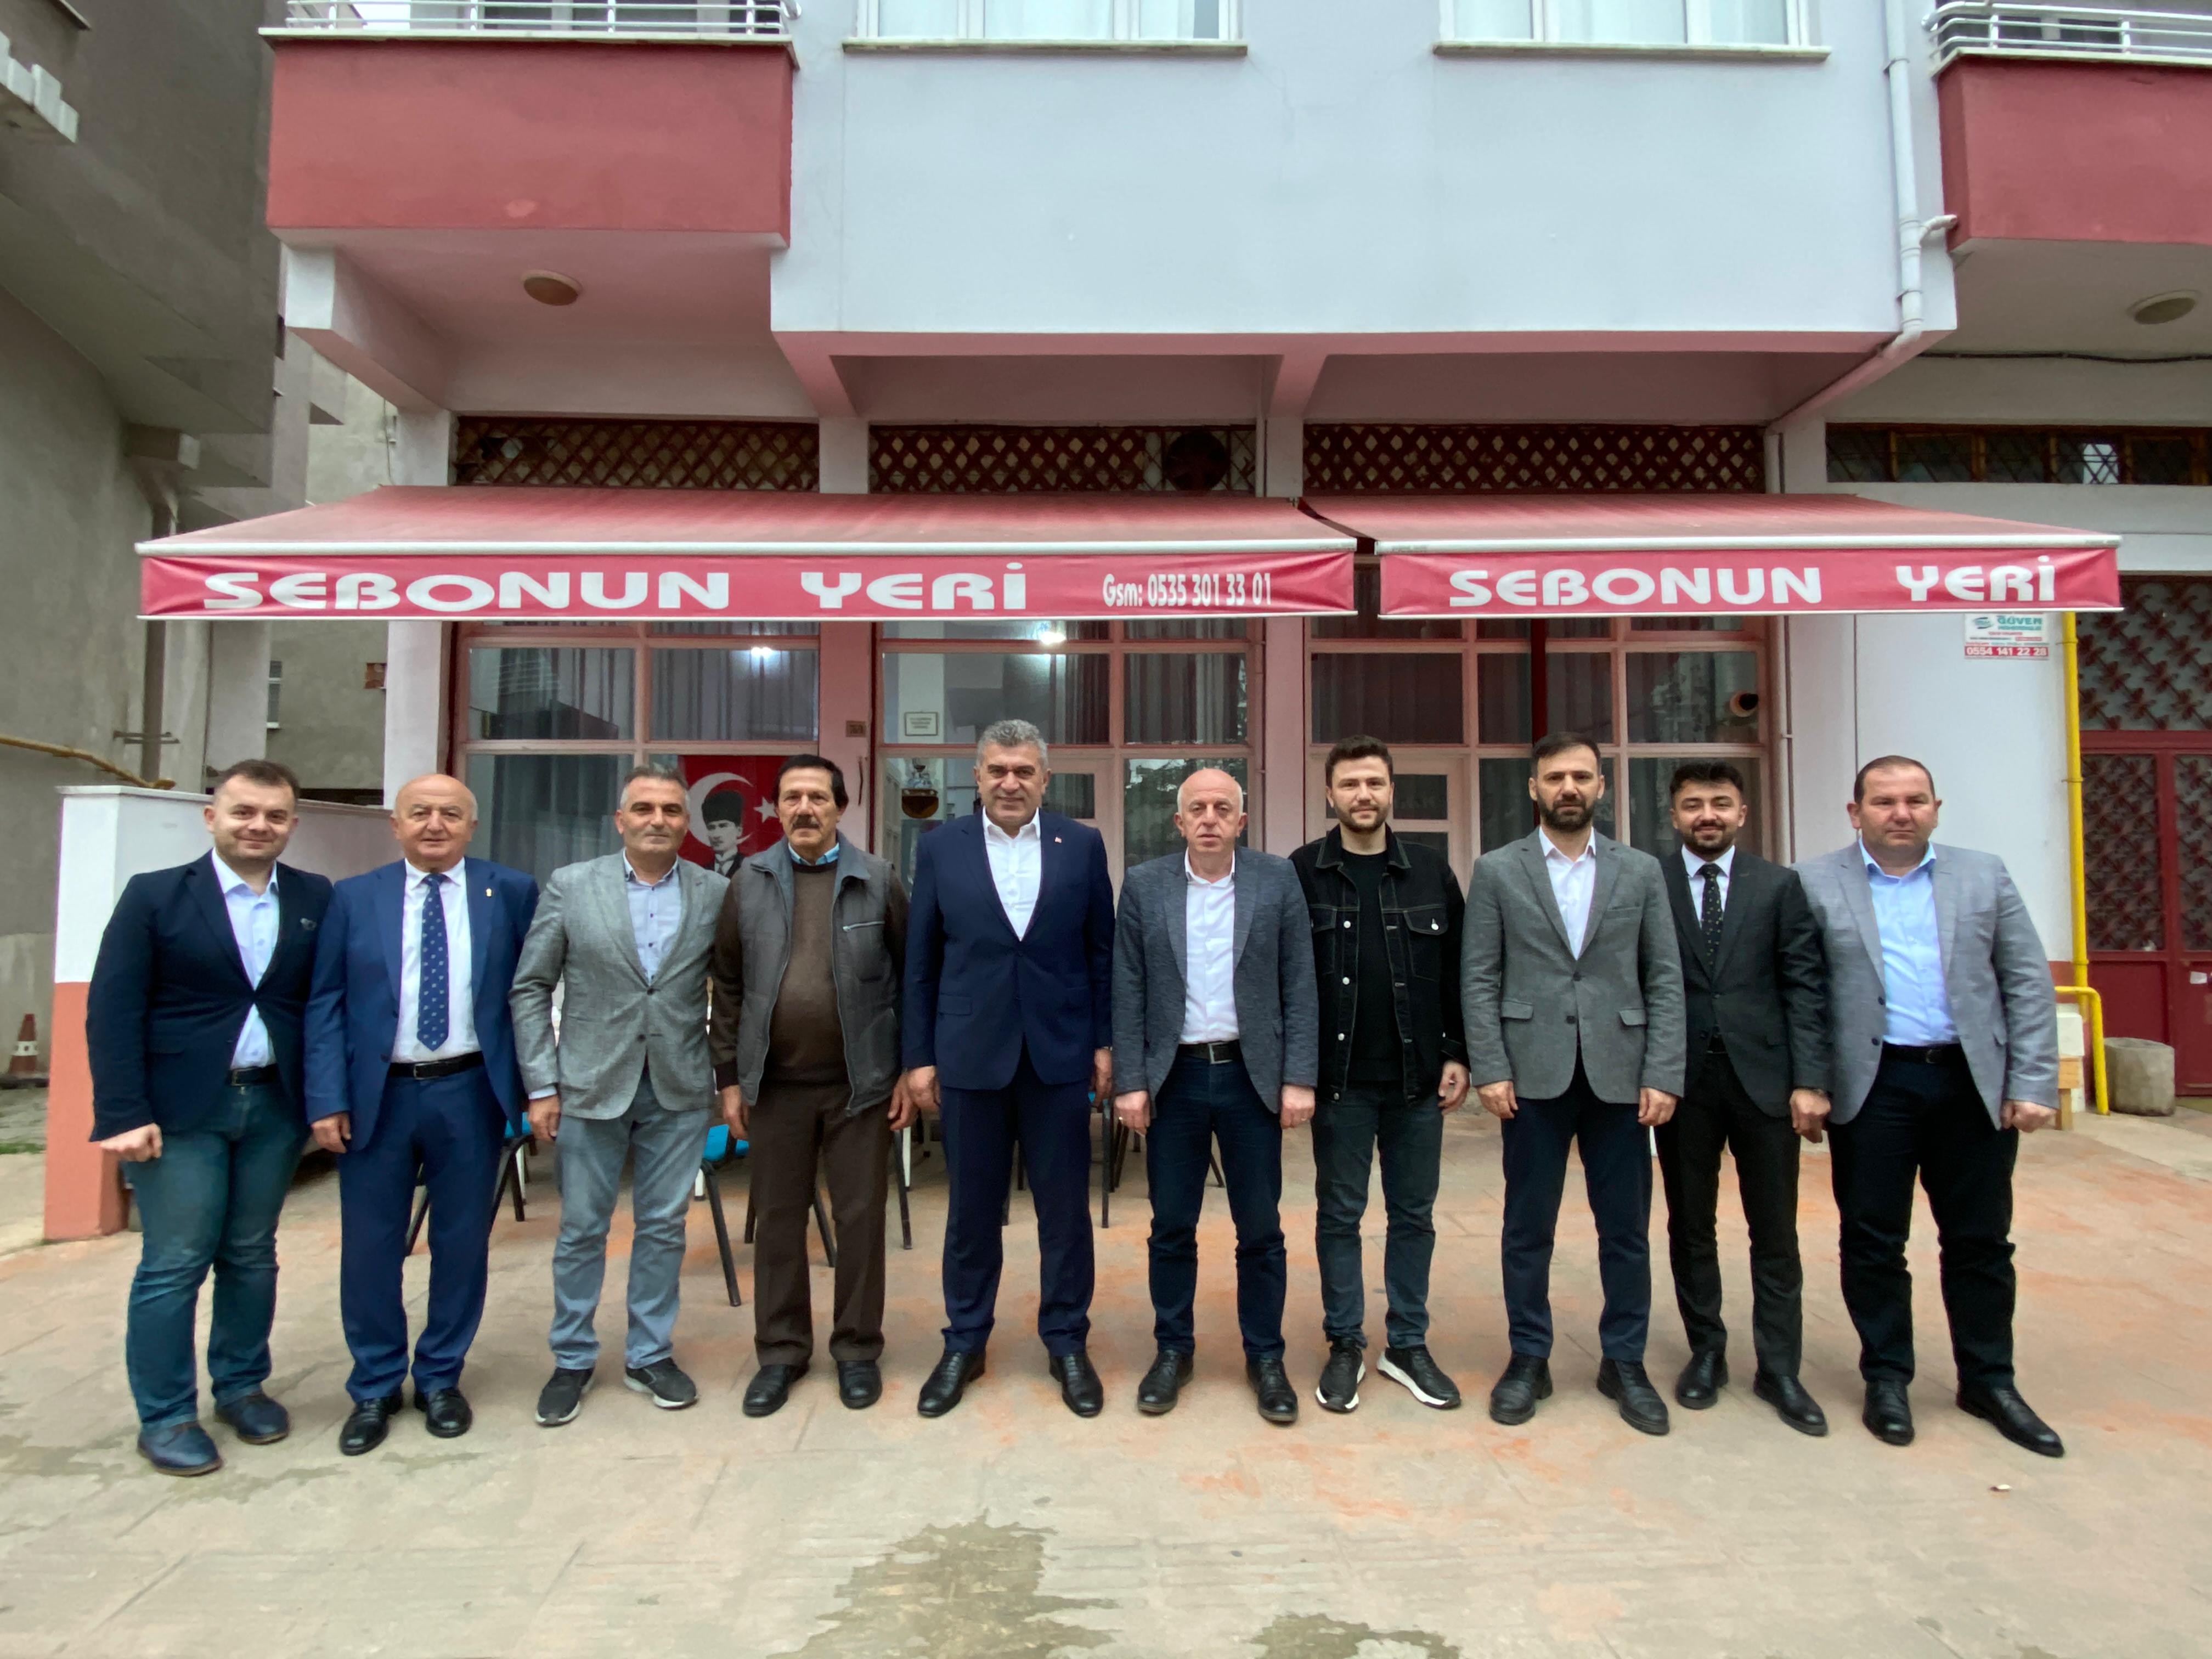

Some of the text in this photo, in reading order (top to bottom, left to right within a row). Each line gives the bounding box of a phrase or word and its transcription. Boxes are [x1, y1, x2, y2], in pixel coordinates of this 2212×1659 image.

[204, 562, 1026, 612] SEBONUN YERİ
[1103, 572, 1271, 607] Gsm: 0535 301 33 01
[1450, 556, 2055, 606] SEBONUN YERİ
[1966, 647, 1993, 656] 0554
[1996, 647, 2013, 656] 141
[2017, 647, 2030, 656] 22
